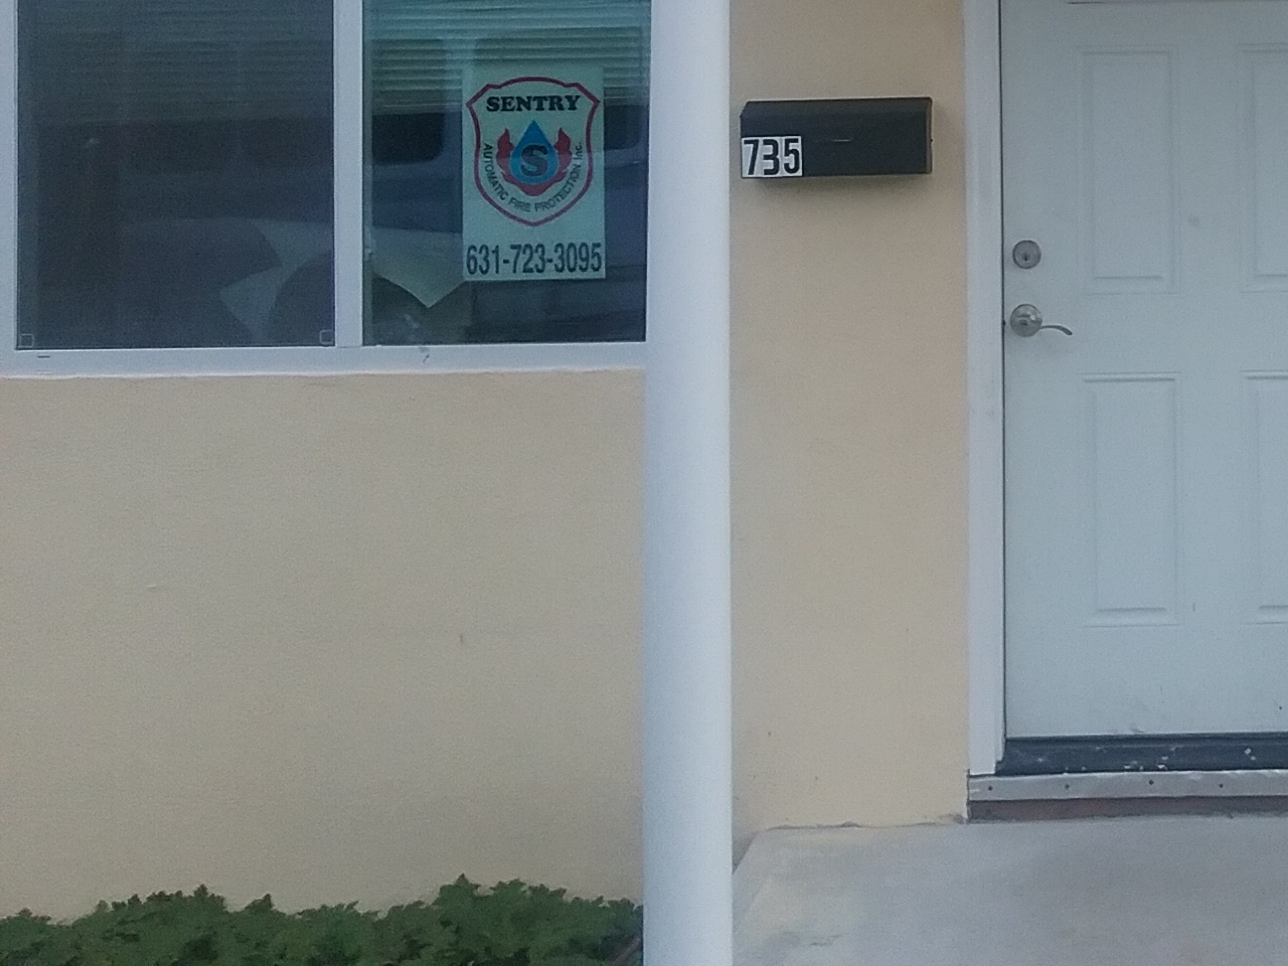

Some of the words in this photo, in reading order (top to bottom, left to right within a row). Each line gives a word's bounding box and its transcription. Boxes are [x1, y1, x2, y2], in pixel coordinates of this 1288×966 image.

[486, 95, 581, 112] SENTRY
[521, 144, 549, 177] S
[744, 138, 800, 176] 735
[483, 142, 509, 201] AUTOMATIC
[508, 197, 532, 212] FIRE
[534, 163, 582, 212] PROTECTION
[573, 141, 583, 160] Inc.
[466, 242, 602, 275] 631-723-3095
